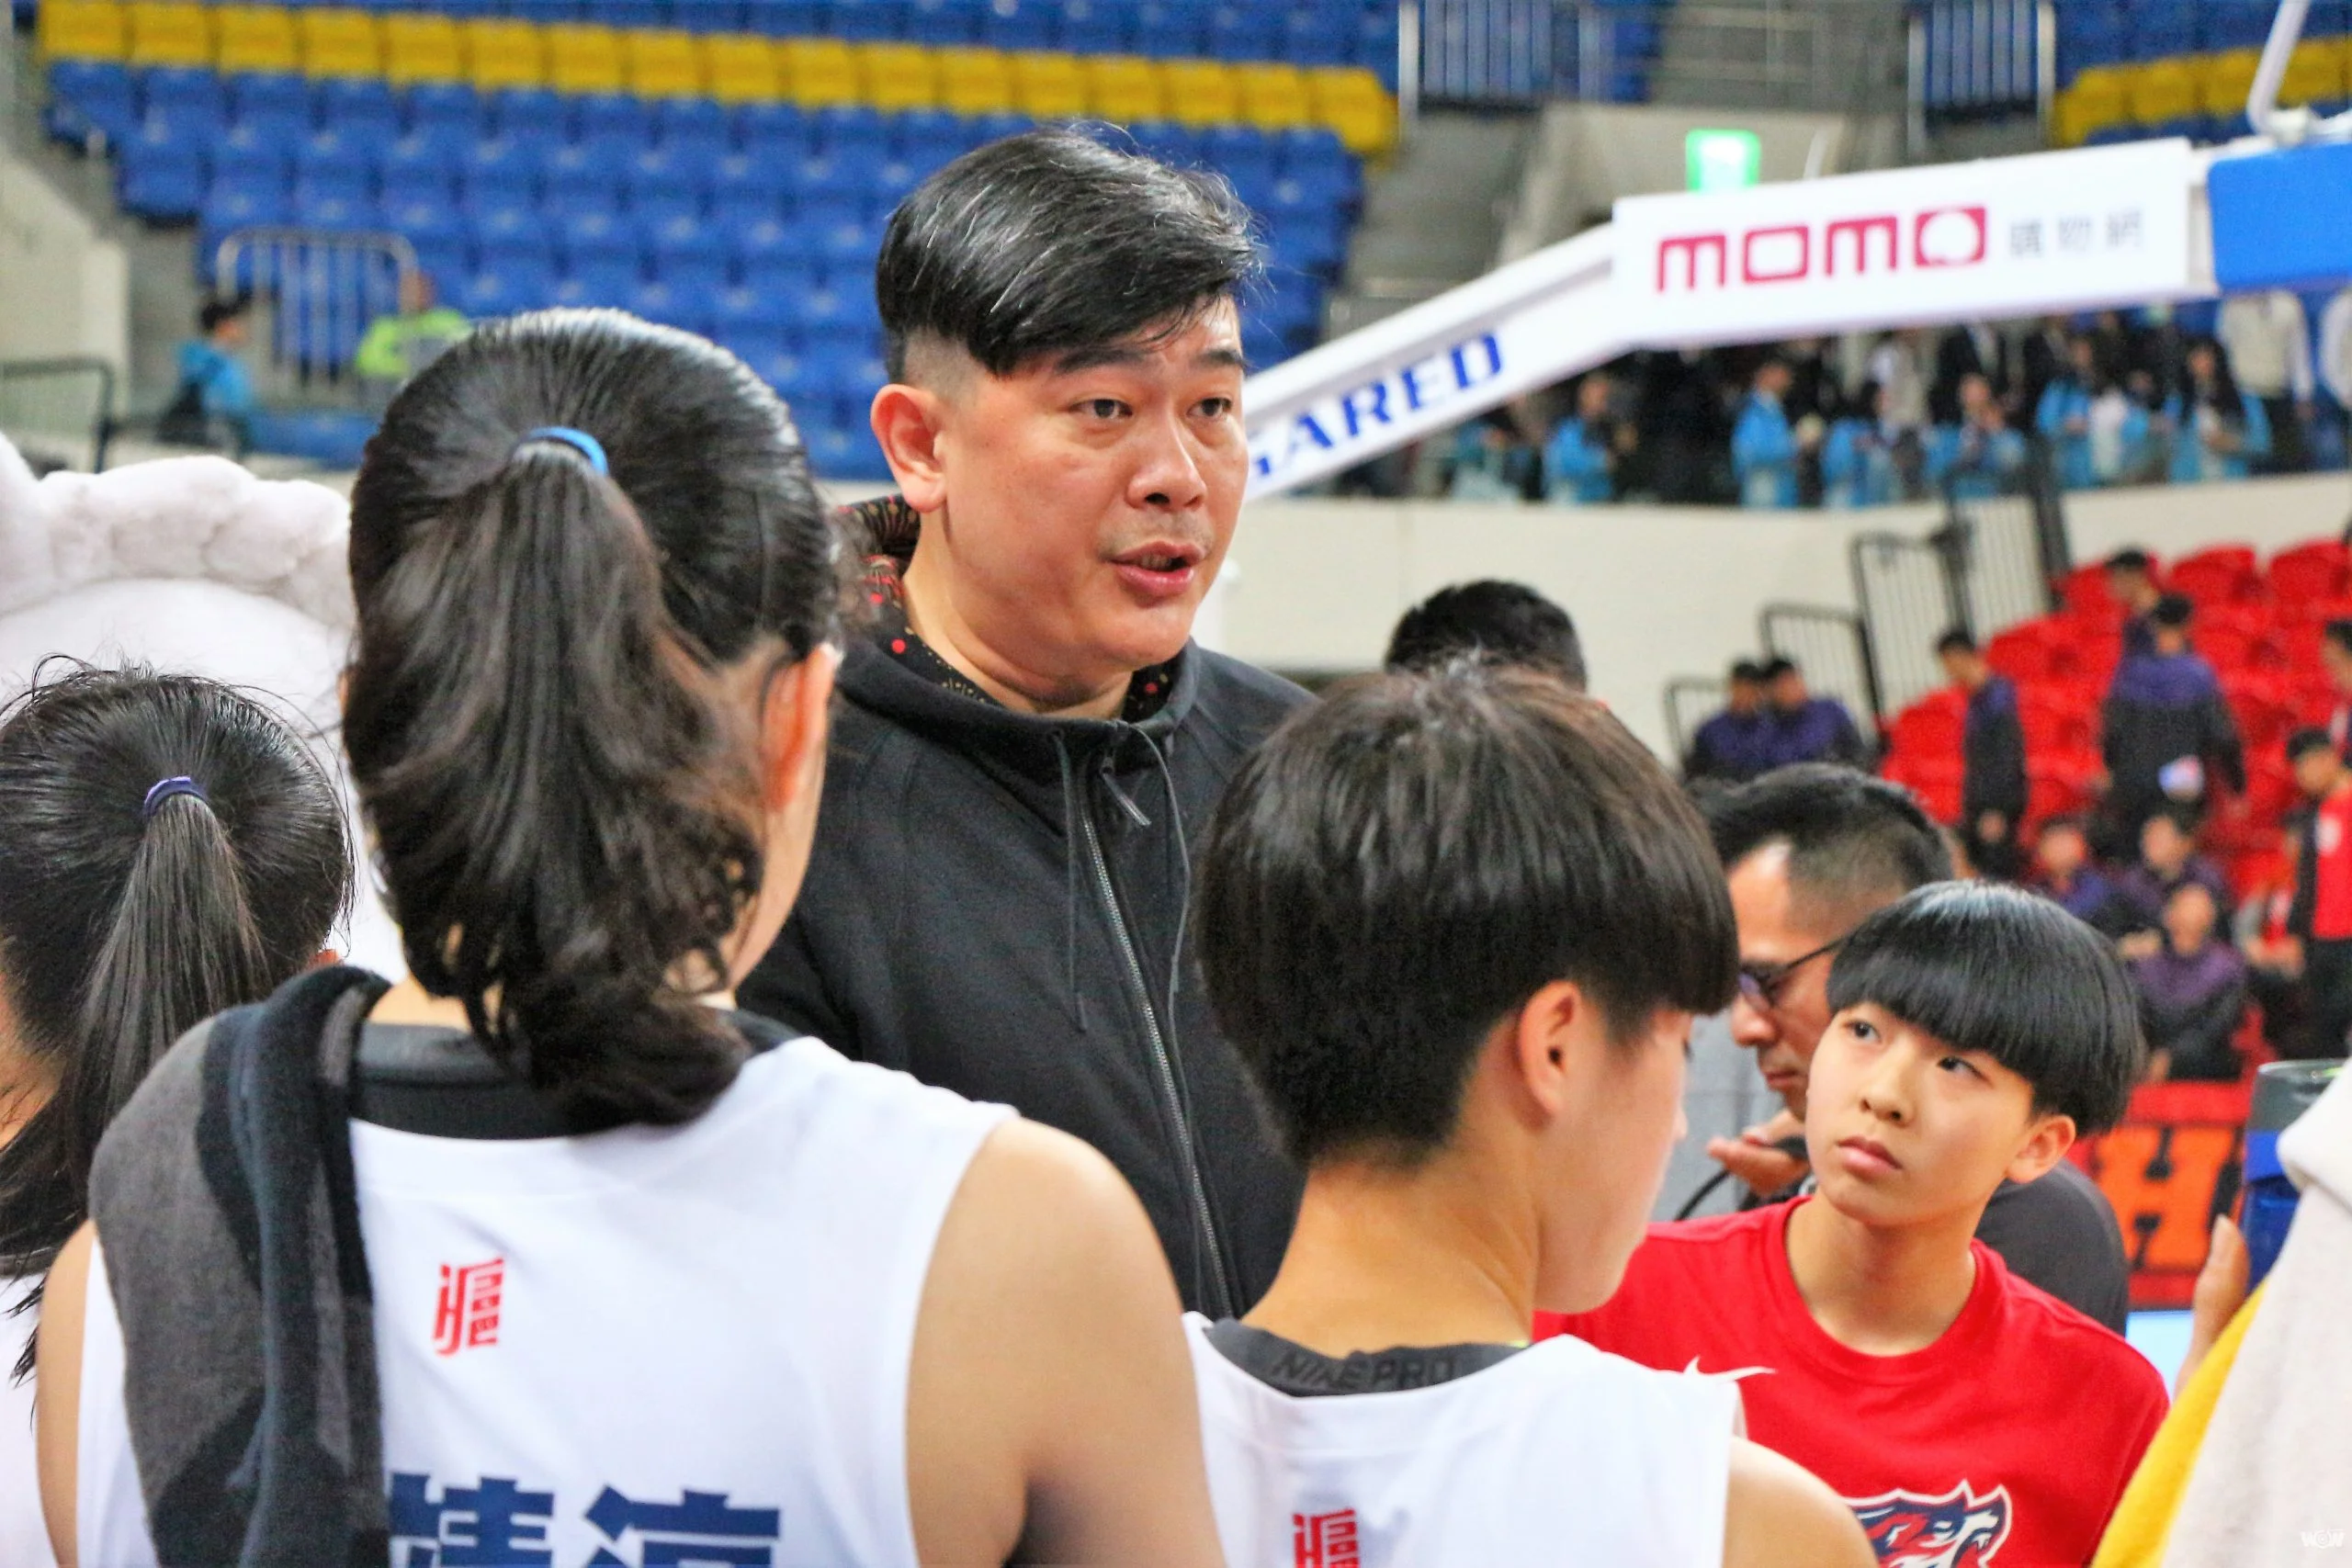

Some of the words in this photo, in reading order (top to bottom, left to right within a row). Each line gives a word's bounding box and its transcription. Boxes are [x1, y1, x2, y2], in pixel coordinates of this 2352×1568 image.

[1657, 206, 1986, 291] momo
[1255, 333, 1502, 476] ARED
[1372, 1356, 1457, 1388] PRO
